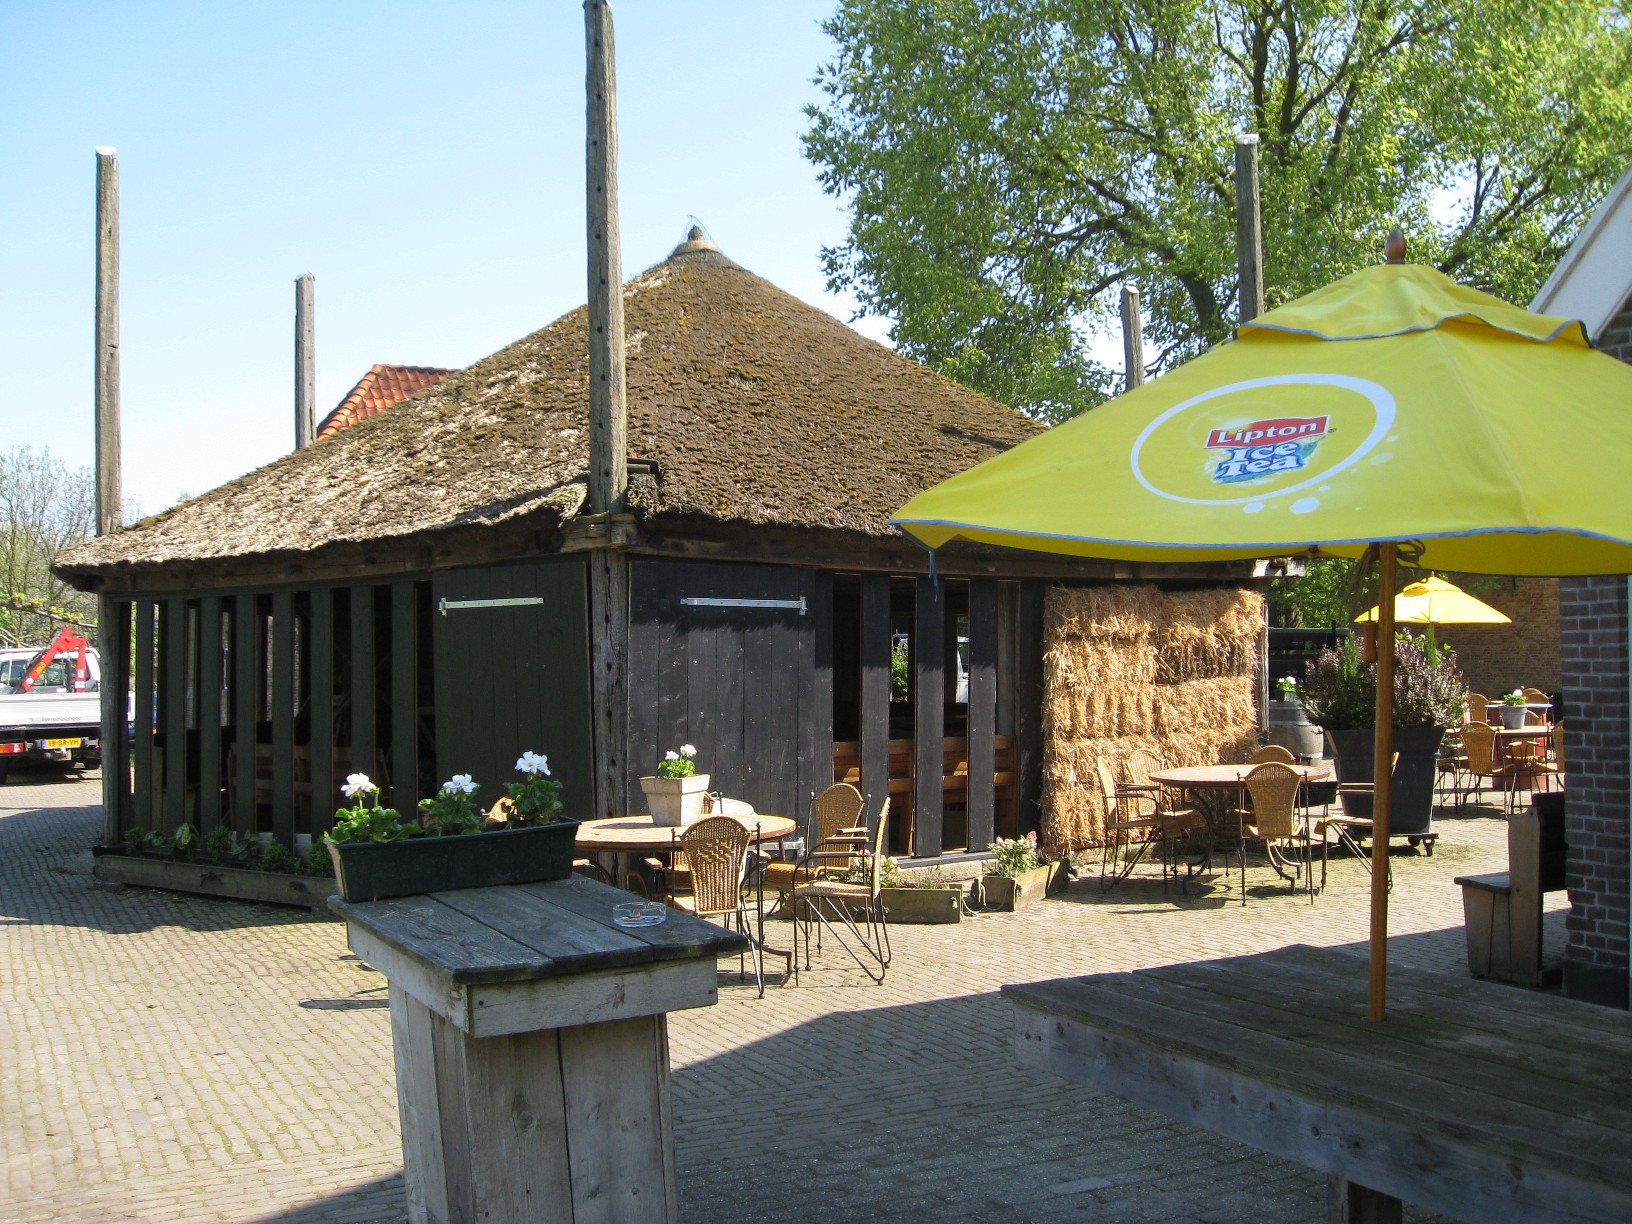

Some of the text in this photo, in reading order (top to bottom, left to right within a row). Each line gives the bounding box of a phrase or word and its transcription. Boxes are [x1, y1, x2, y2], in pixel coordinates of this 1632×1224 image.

[1217, 422, 1317, 443] Lipton
[1231, 443, 1298, 461] Ice
[1220, 456, 1299, 477] Tea
